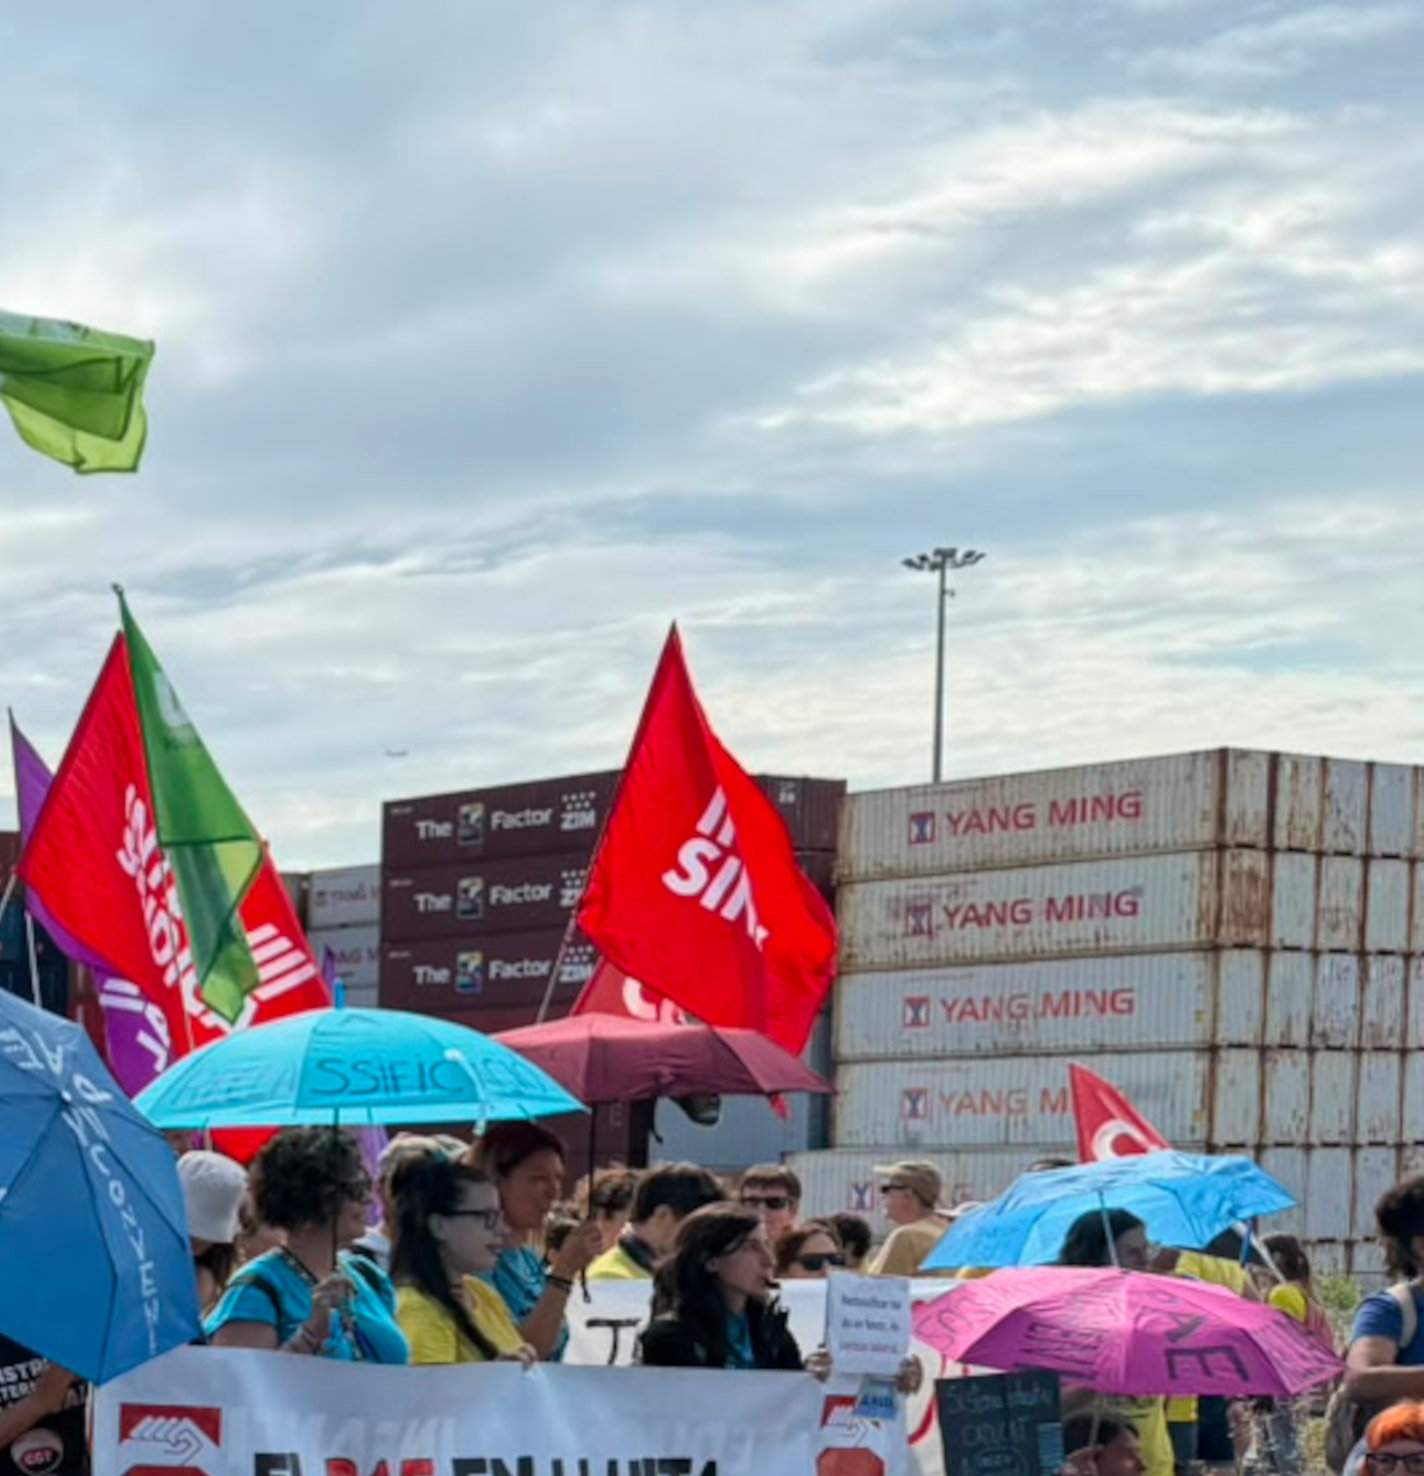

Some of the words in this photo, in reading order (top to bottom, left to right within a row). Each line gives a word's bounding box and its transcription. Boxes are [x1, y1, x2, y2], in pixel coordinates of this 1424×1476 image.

[490, 806, 552, 832] Factor
[560, 809, 596, 831] ZIM
[946, 803, 1038, 838] YANG
[1048, 791, 1142, 827] MING
[489, 884, 552, 906] Factor
[942, 897, 1033, 930] YANG
[1044, 889, 1140, 923] MING
[488, 958, 551, 980] Factor
[940, 992, 1029, 1022] YANG
[1041, 987, 1136, 1018] MING
[938, 1087, 1028, 1117] YANG
